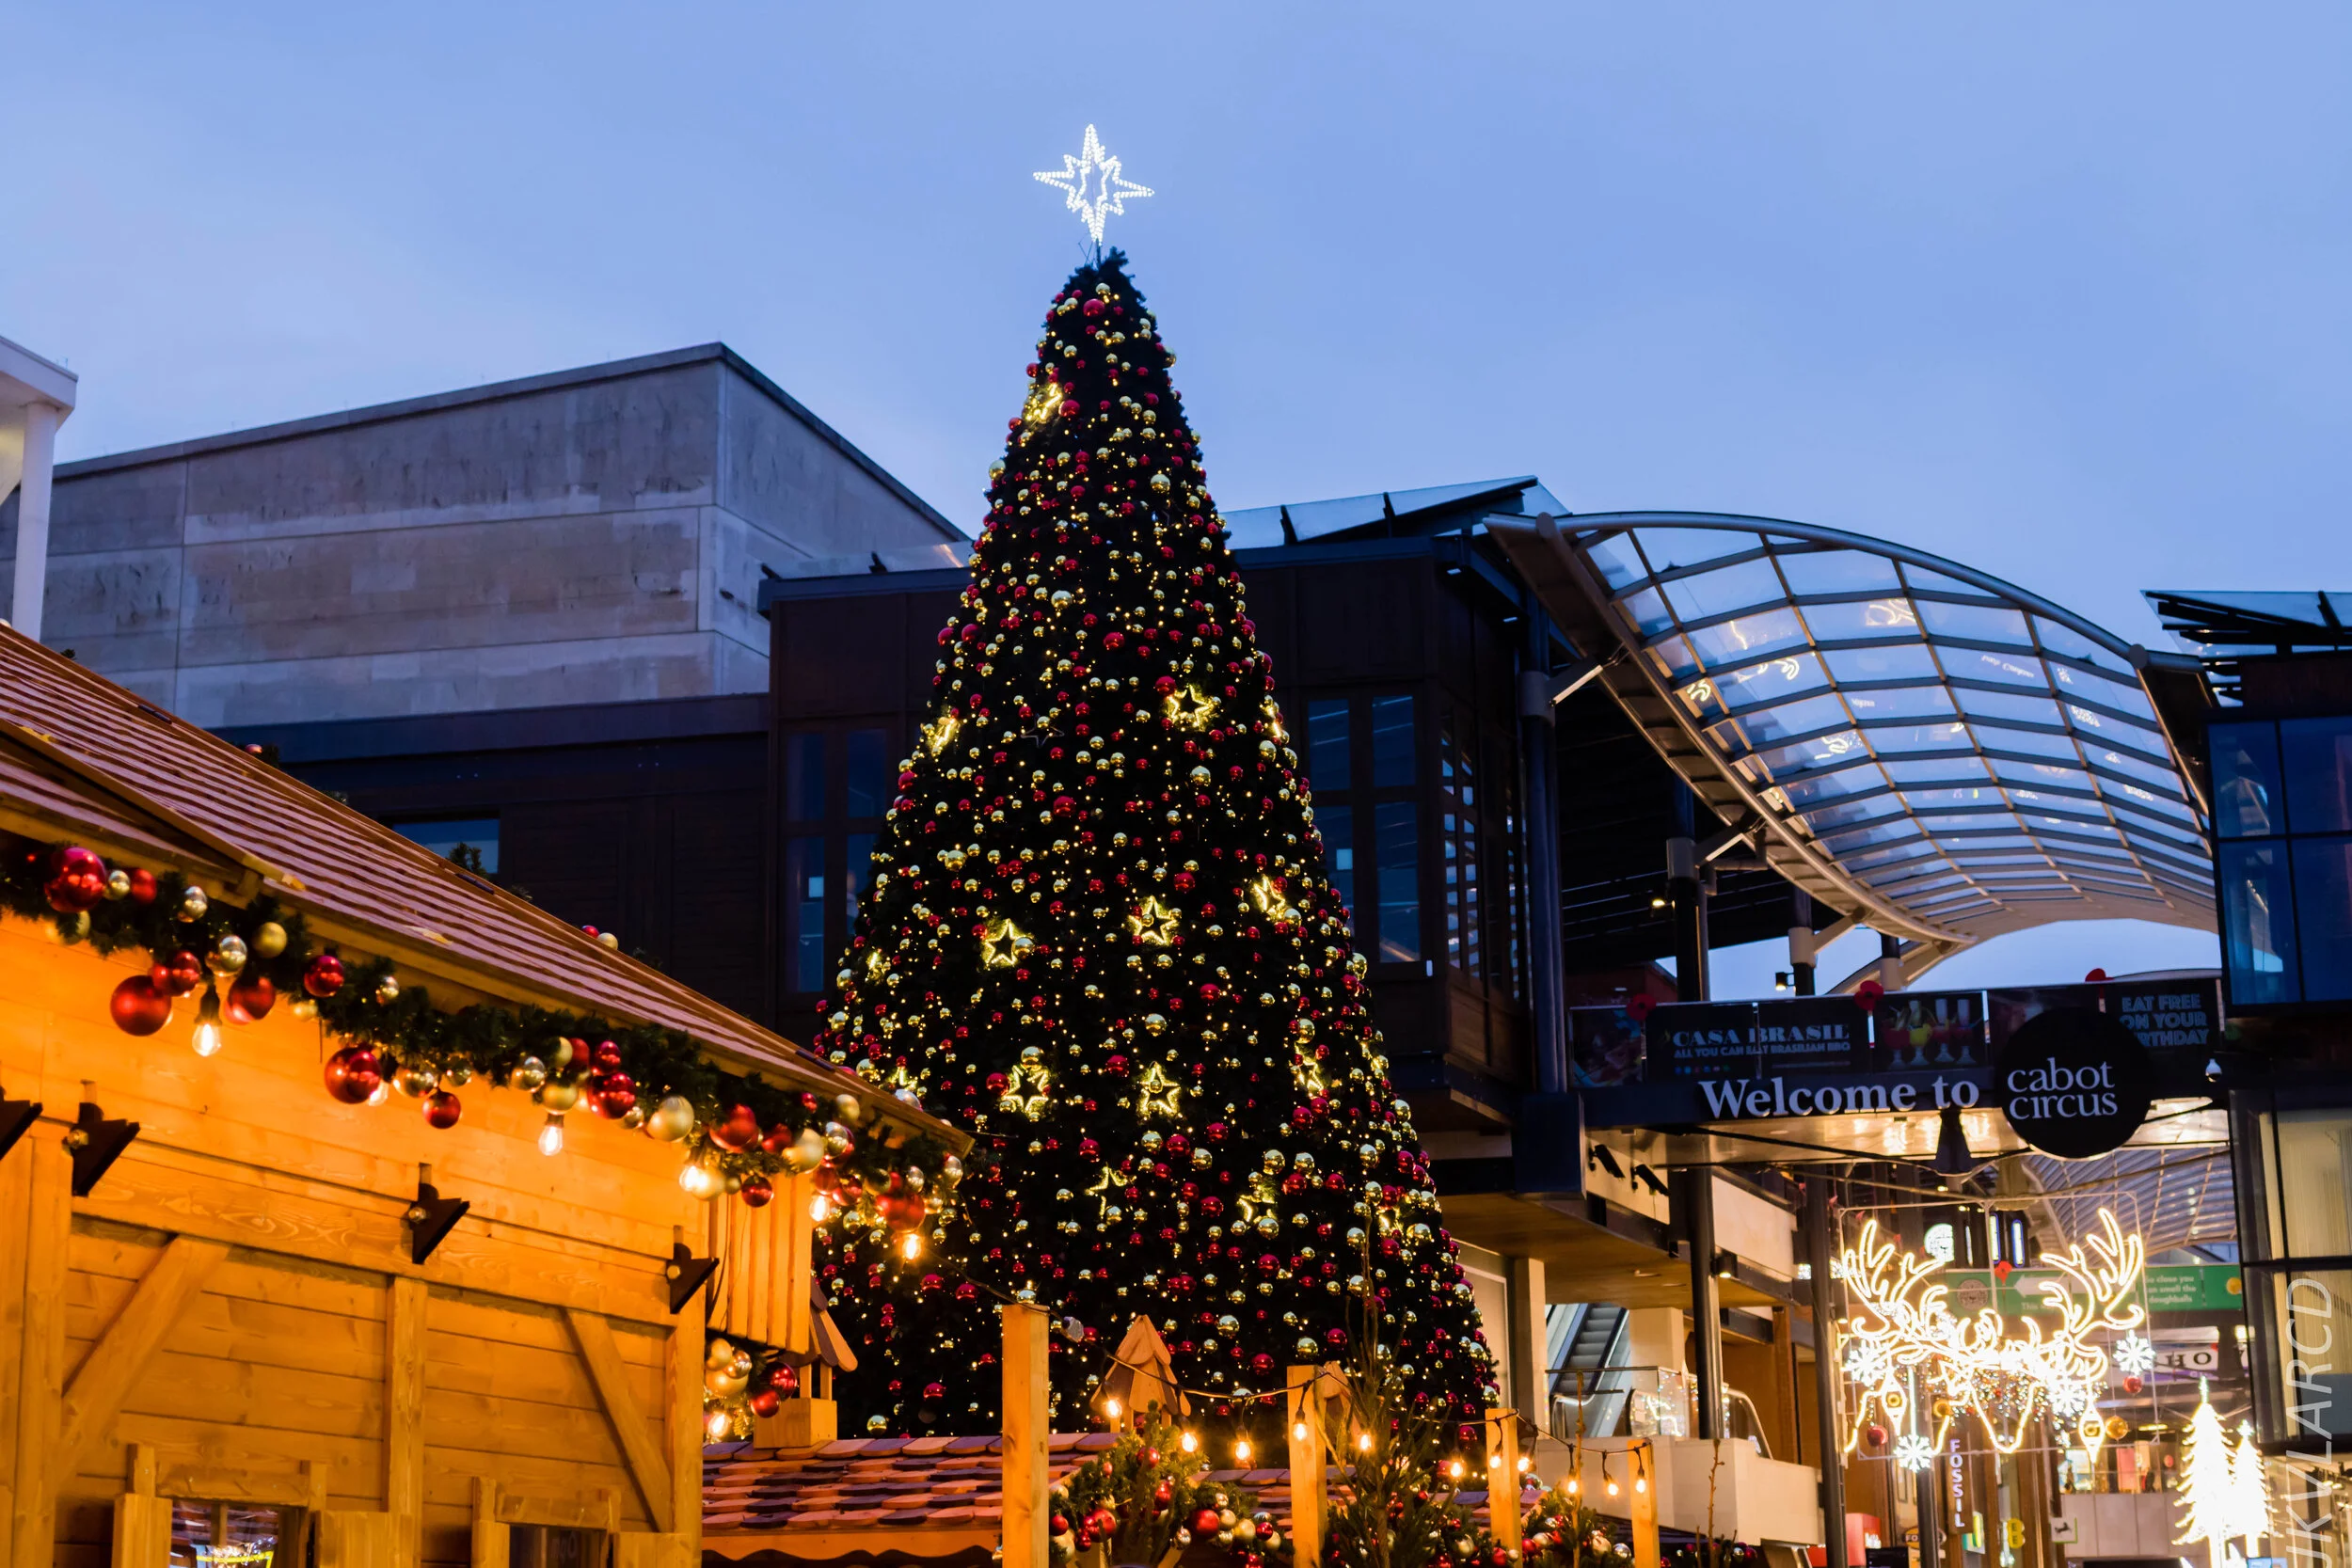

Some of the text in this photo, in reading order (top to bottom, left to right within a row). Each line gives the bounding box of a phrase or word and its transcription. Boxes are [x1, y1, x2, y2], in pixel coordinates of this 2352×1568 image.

[2122, 993, 2201, 1013] EAT FREE
[2119, 1011, 2208, 1030] ON YOUR
[1673, 1024, 1851, 1047] CASA BRASIL
[2135, 1029, 2209, 1048] RTHDAY
[1674, 1049, 1692, 1058] ALL
[1694, 1048, 1719, 1057] YOU
[1721, 1046, 1743, 1056] CAN
[1771, 1042, 1825, 1054] BRASILIAN
[2007, 1056, 2116, 1093] cabot
[1698, 1075, 1979, 1119] Welcome to
[2009, 1093, 2118, 1120] circus
[2179, 1275, 2194, 1284] you
[2183, 1284, 2197, 1292] the
[1949, 1439, 1964, 1528] FOSSIL
